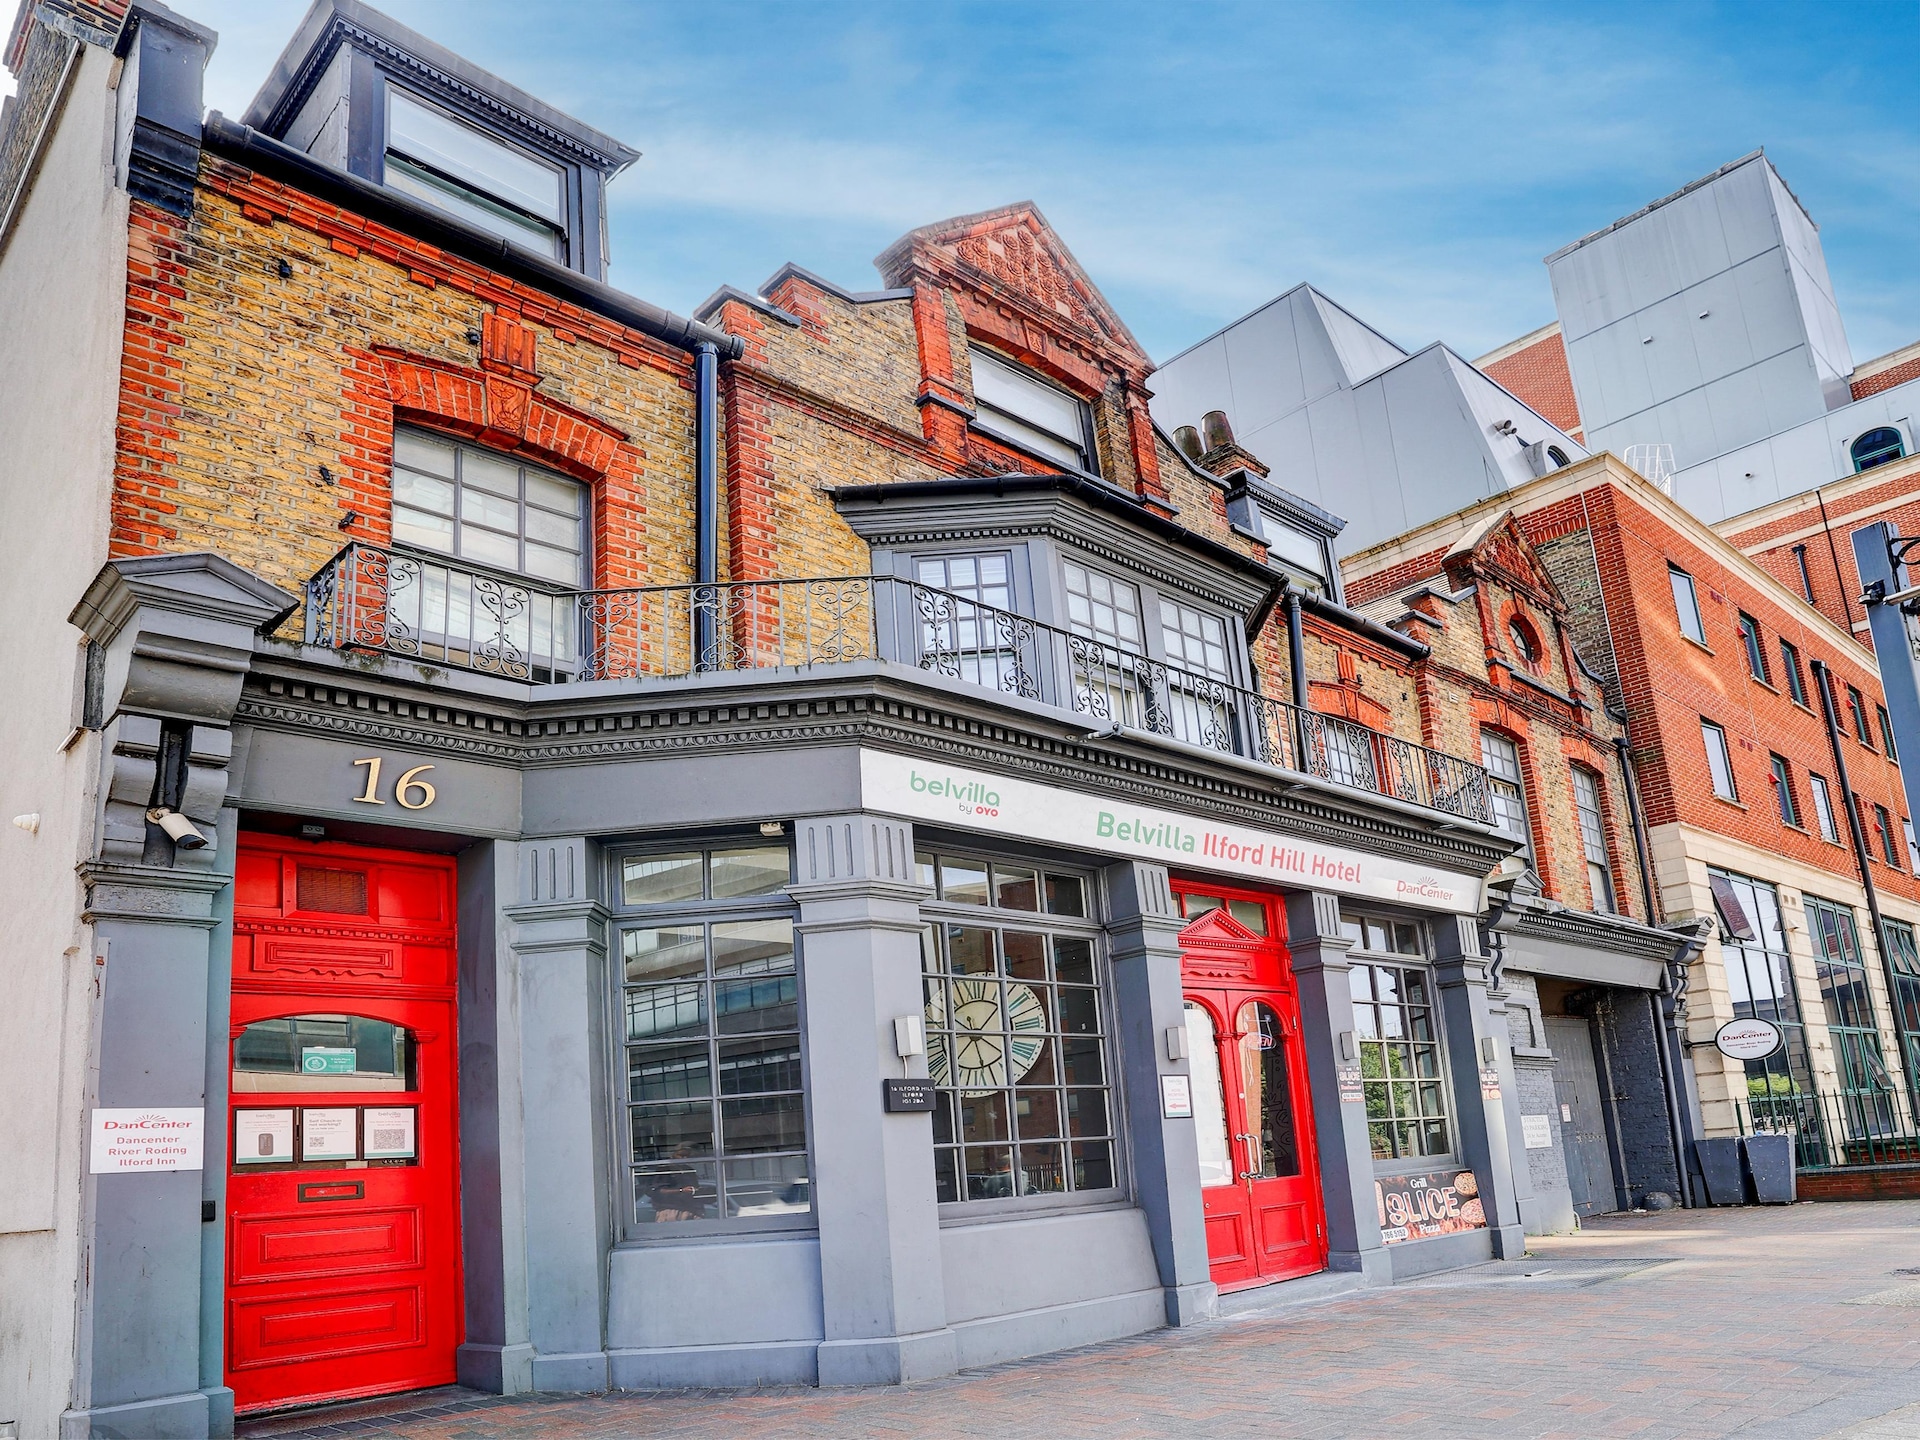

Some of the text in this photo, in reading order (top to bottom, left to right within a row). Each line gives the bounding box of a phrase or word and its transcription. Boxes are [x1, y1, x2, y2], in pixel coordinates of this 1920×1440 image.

[353, 757, 436, 809] 16
[910, 770, 1000, 807] belvilla
[958, 802, 973, 815] by
[1096, 811, 1362, 884] Belvilla Ilford Hill Hotel
[1396, 879, 1454, 901] DanCenter
[1722, 1032, 1772, 1041] DanCenter
[103, 1120, 193, 1130] DanCenter
[116, 1136, 180, 1145] Dancenter
[108, 1147, 187, 1156] River Roding
[119, 1158, 153, 1167] Ilford
[1410, 1177, 1428, 1189] Grill
[1385, 1187, 1461, 1226] SLICE
[1419, 1222, 1441, 1234] Pizza
